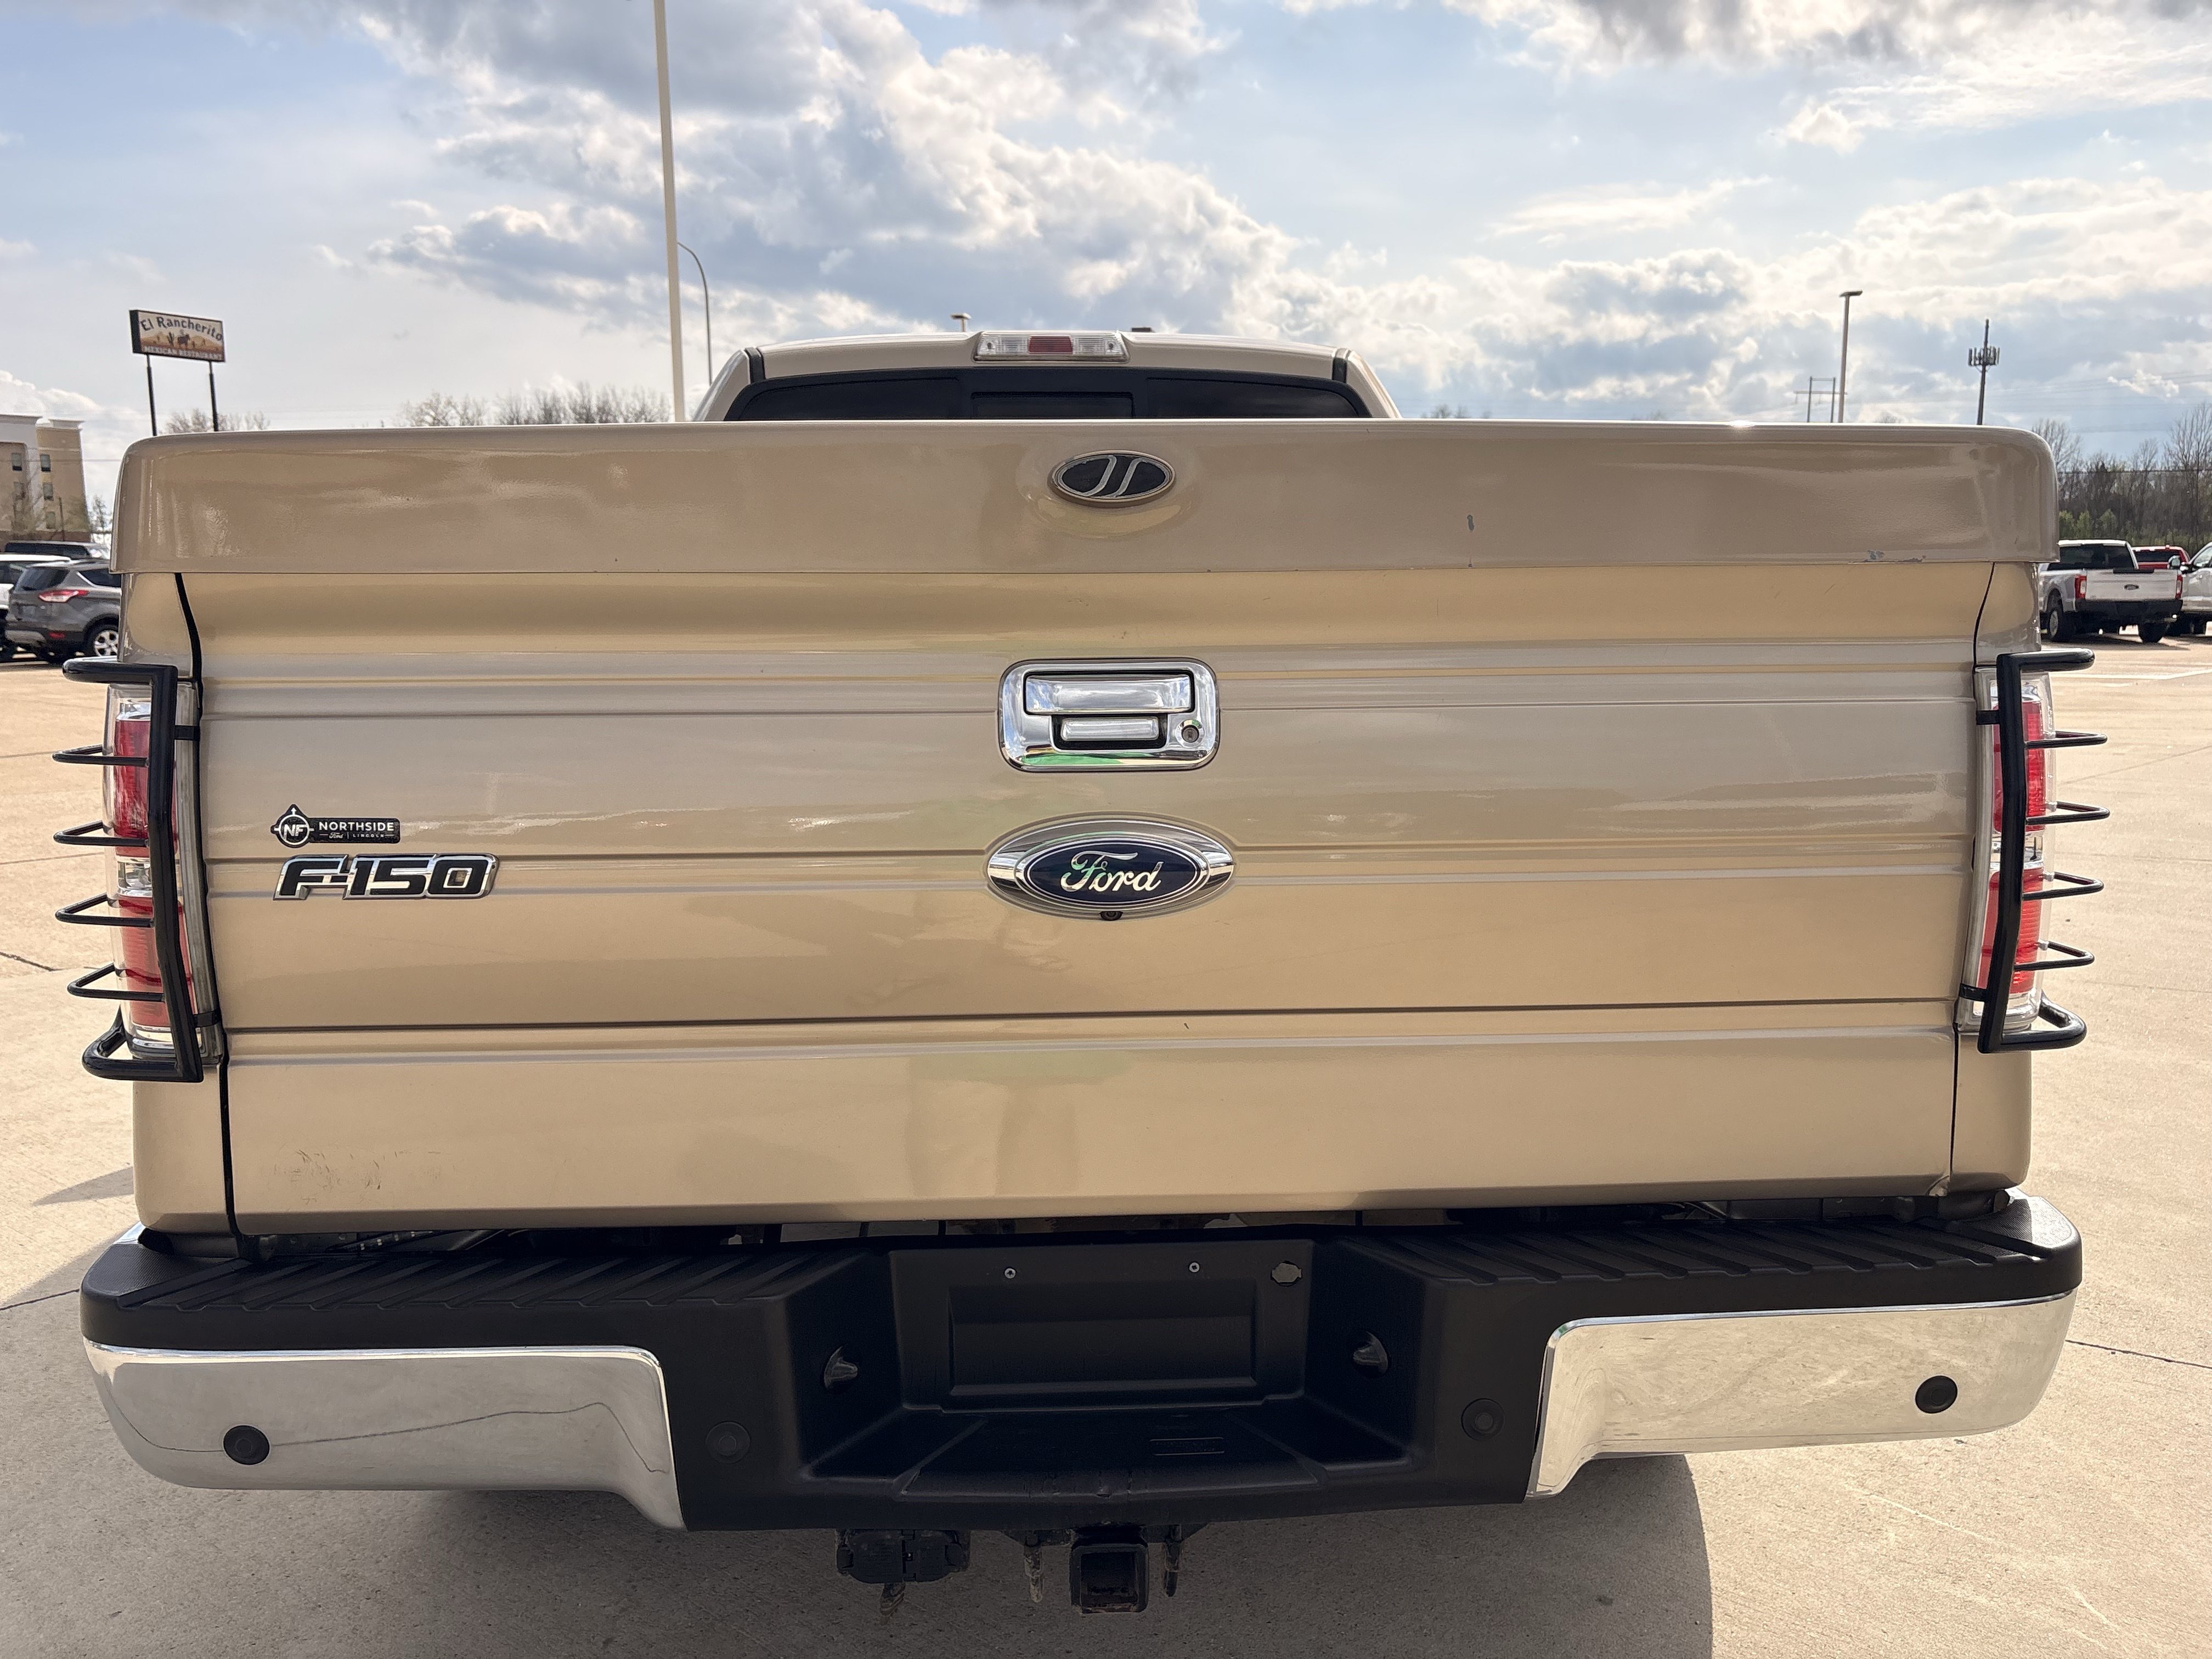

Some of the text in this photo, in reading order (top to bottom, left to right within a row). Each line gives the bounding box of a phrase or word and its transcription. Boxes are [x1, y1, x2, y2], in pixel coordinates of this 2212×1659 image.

[140, 317, 222, 341] El Rancherito
[284, 823, 307, 838] NF
[319, 822, 394, 831] NORTHSIDE
[273, 854, 500, 900] F-150
[1060, 850, 1164, 892] Ford
